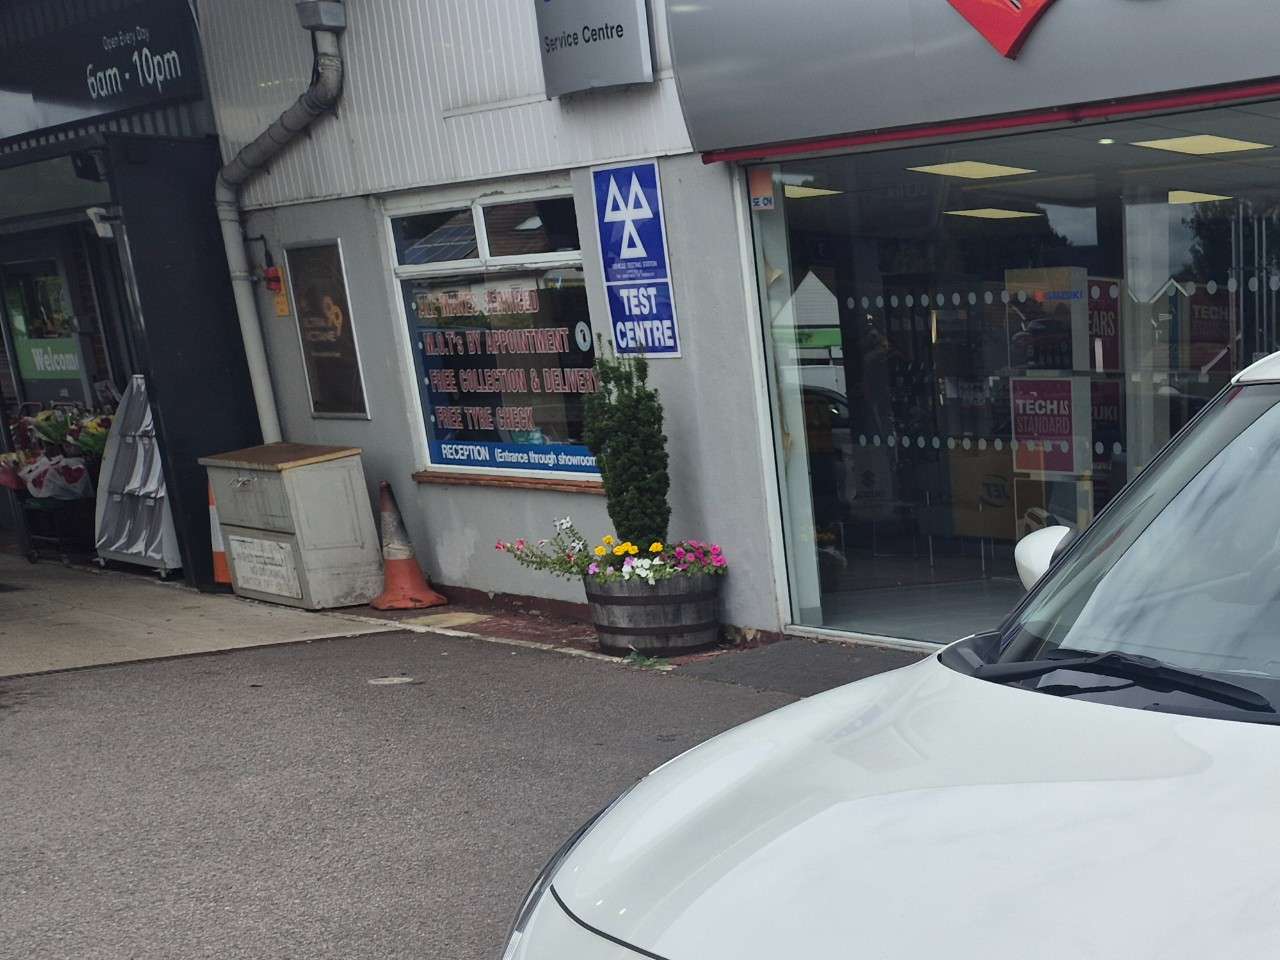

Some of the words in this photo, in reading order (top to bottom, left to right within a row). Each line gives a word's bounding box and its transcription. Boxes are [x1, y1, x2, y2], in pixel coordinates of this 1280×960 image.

[544, 31, 579, 53] Service
[582, 23, 624, 43] Centre
[87, 64, 122, 99] 6am
[132, 47, 181, 94] 10pm
[620, 287, 657, 316] TEST
[616, 319, 675, 348] CENTRE
[1088, 310, 1116, 337] EARS
[465, 330, 481, 354] BY
[485, 327, 570, 354] APPOINTMENT
[429, 368, 458, 393] FREE
[459, 367, 527, 393] COLLECTION
[530, 368, 541, 393] &
[542, 367, 600, 393] DELIVERY
[435, 406, 464, 429] FREE
[464, 406, 494, 430] TYRE
[495, 406, 536, 431] CHECK
[1016, 399, 1058, 415] TECH
[1016, 416, 1070, 434] STANDARD
[441, 444, 490, 461] RECEPTION
[529, 451, 557, 467] through
